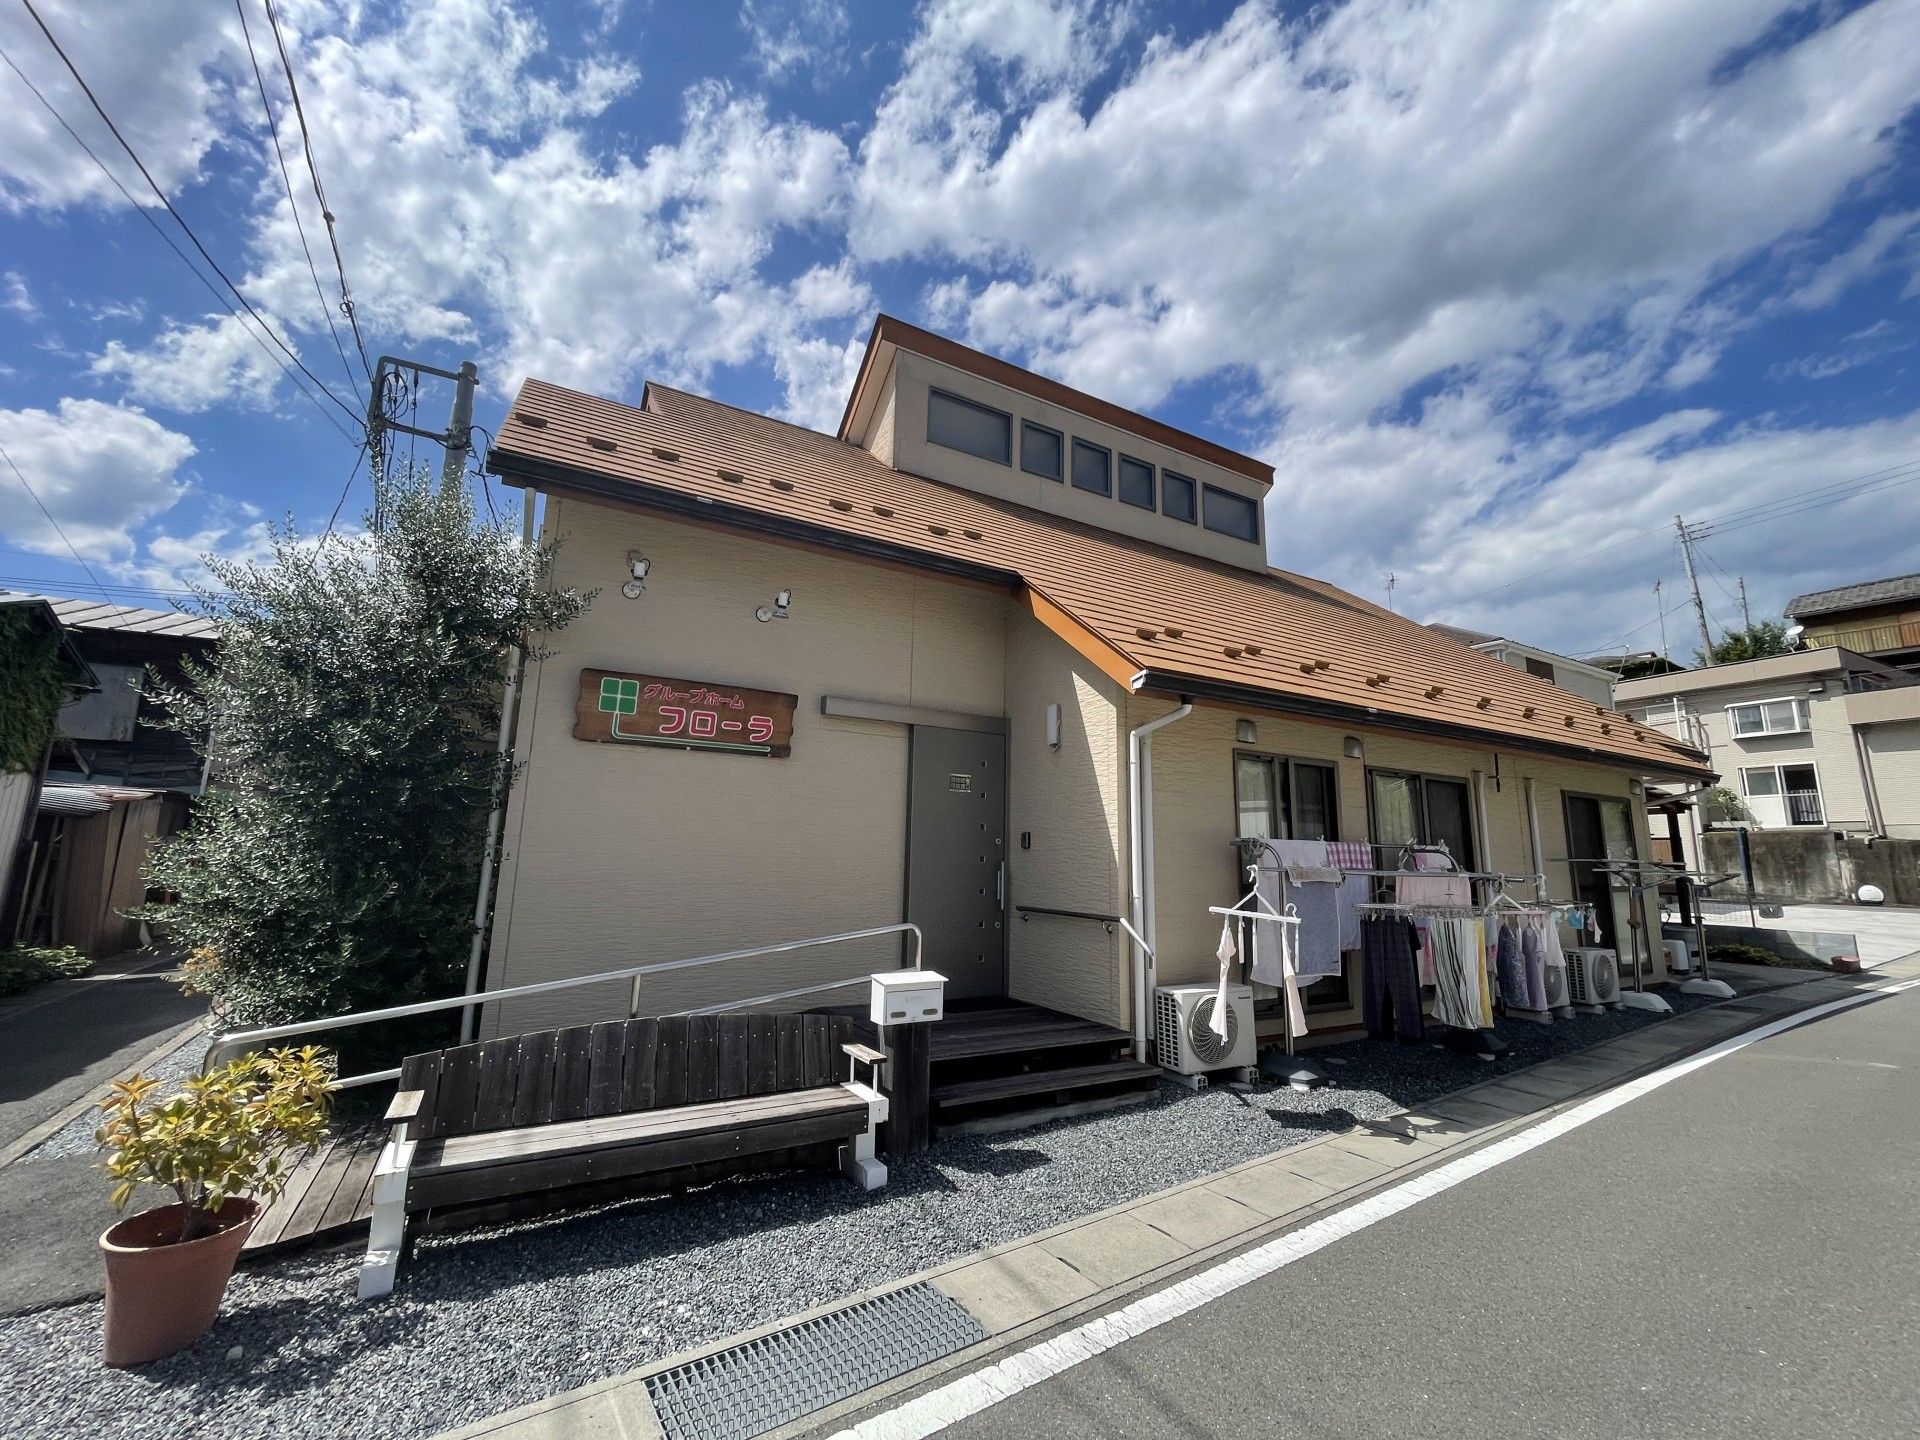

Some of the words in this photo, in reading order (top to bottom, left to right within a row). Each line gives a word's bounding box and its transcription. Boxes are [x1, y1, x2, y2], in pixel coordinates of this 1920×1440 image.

[643, 684, 745, 709] グループホーム
[658, 706, 773, 742] フローラ
